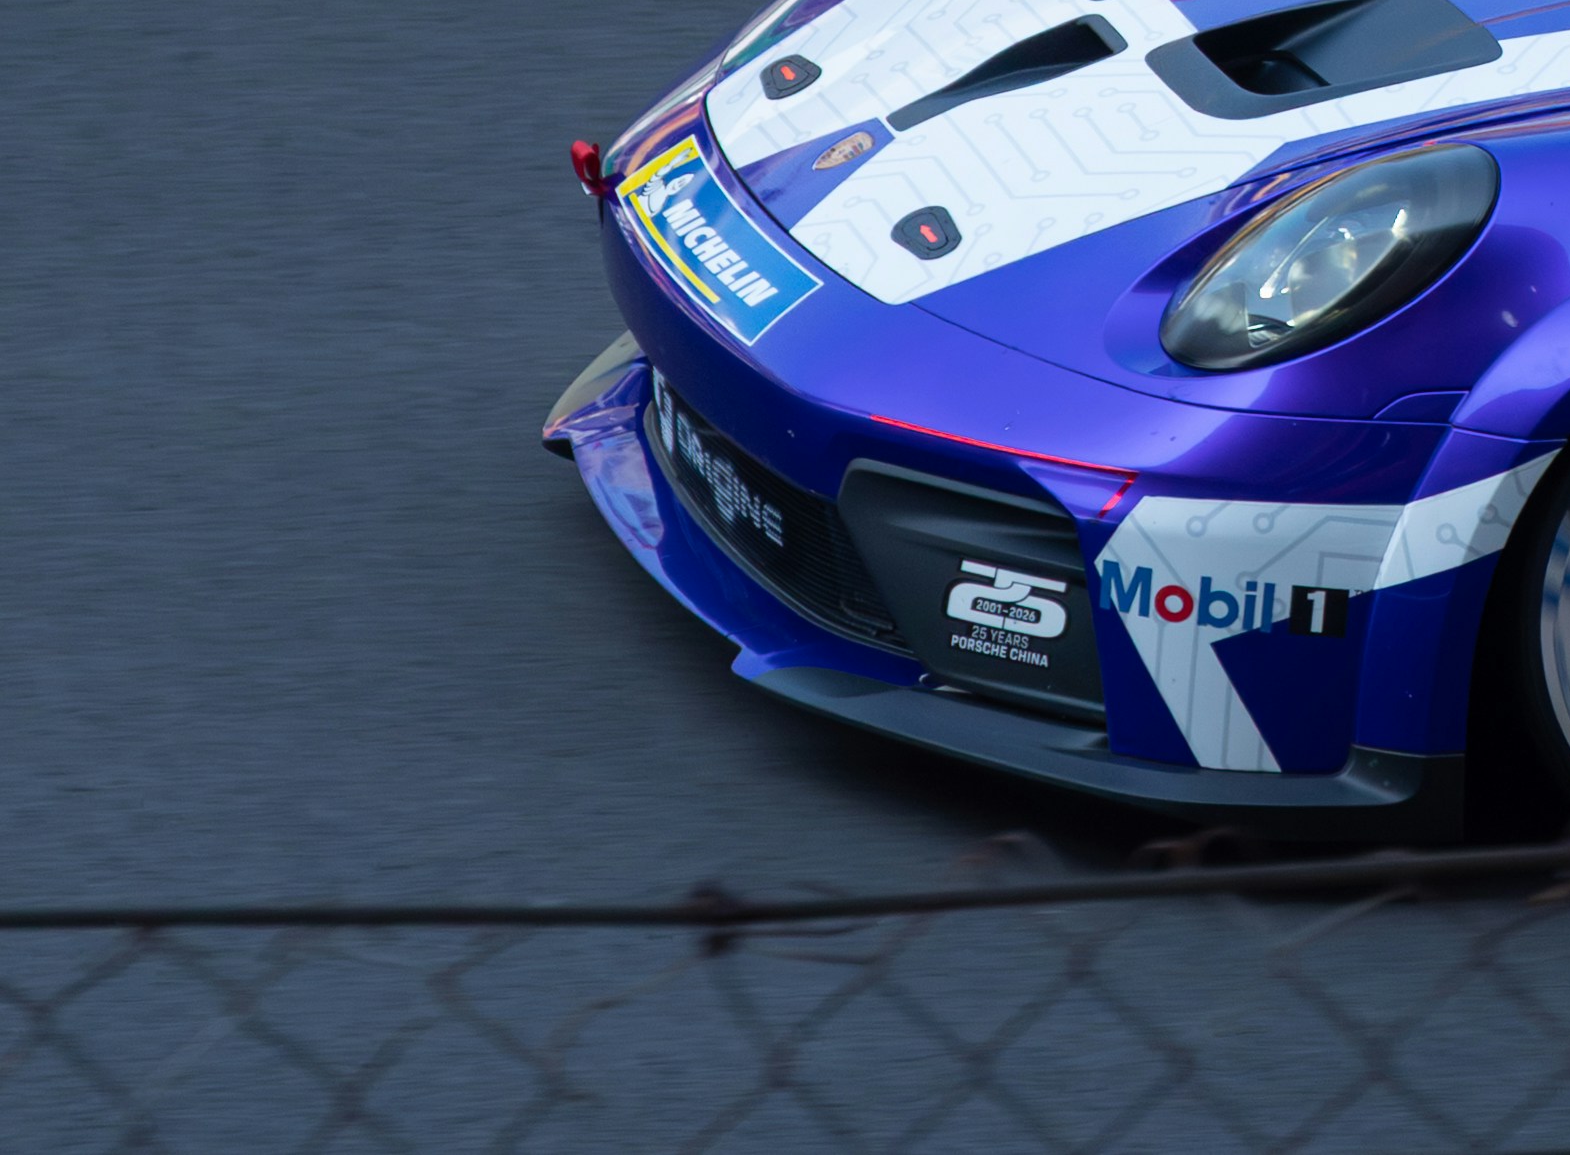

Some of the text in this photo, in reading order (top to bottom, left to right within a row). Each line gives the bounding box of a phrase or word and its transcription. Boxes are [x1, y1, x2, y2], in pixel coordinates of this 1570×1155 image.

[662, 198, 779, 307] MICHELIN
[975, 598, 1037, 623] 2001-2026
[1099, 559, 1327, 634] Mobil 1
[950, 634, 1049, 668] PORSCHE CHINA
[970, 625, 1030, 649] 25 YEARS
